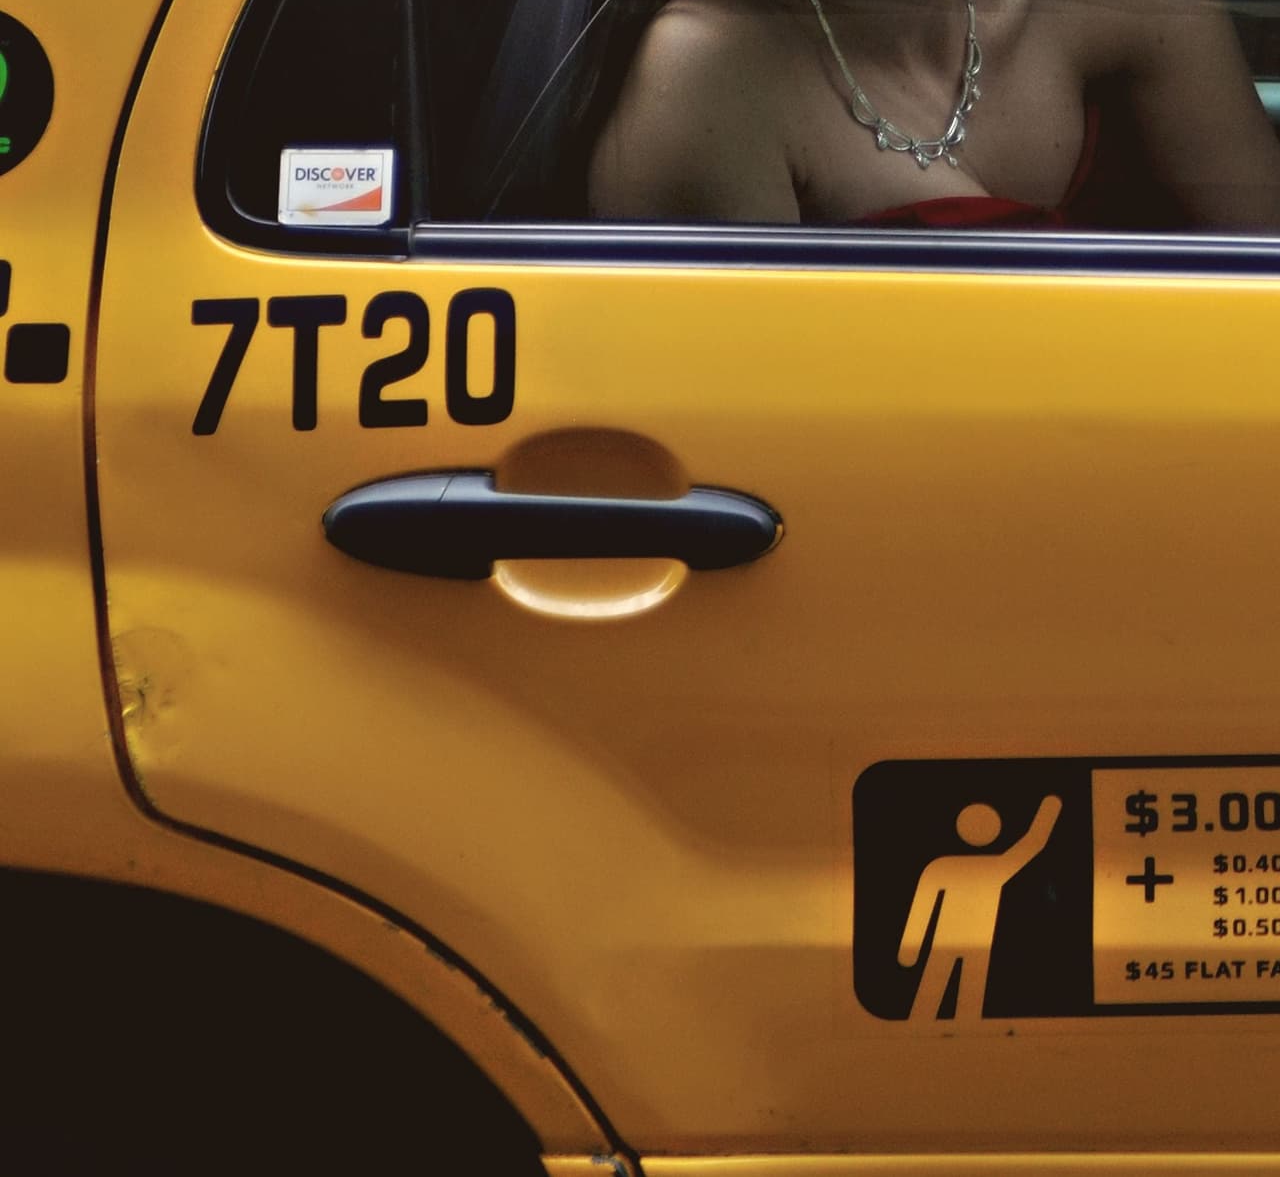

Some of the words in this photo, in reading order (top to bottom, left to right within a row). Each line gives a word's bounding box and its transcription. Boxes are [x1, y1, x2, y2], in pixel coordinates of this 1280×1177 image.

[295, 167, 375, 182] DISCOVER
[191, 288, 516, 436] 7T20
[1124, 959, 1175, 983] $45
[1184, 959, 1247, 980] FLAT
